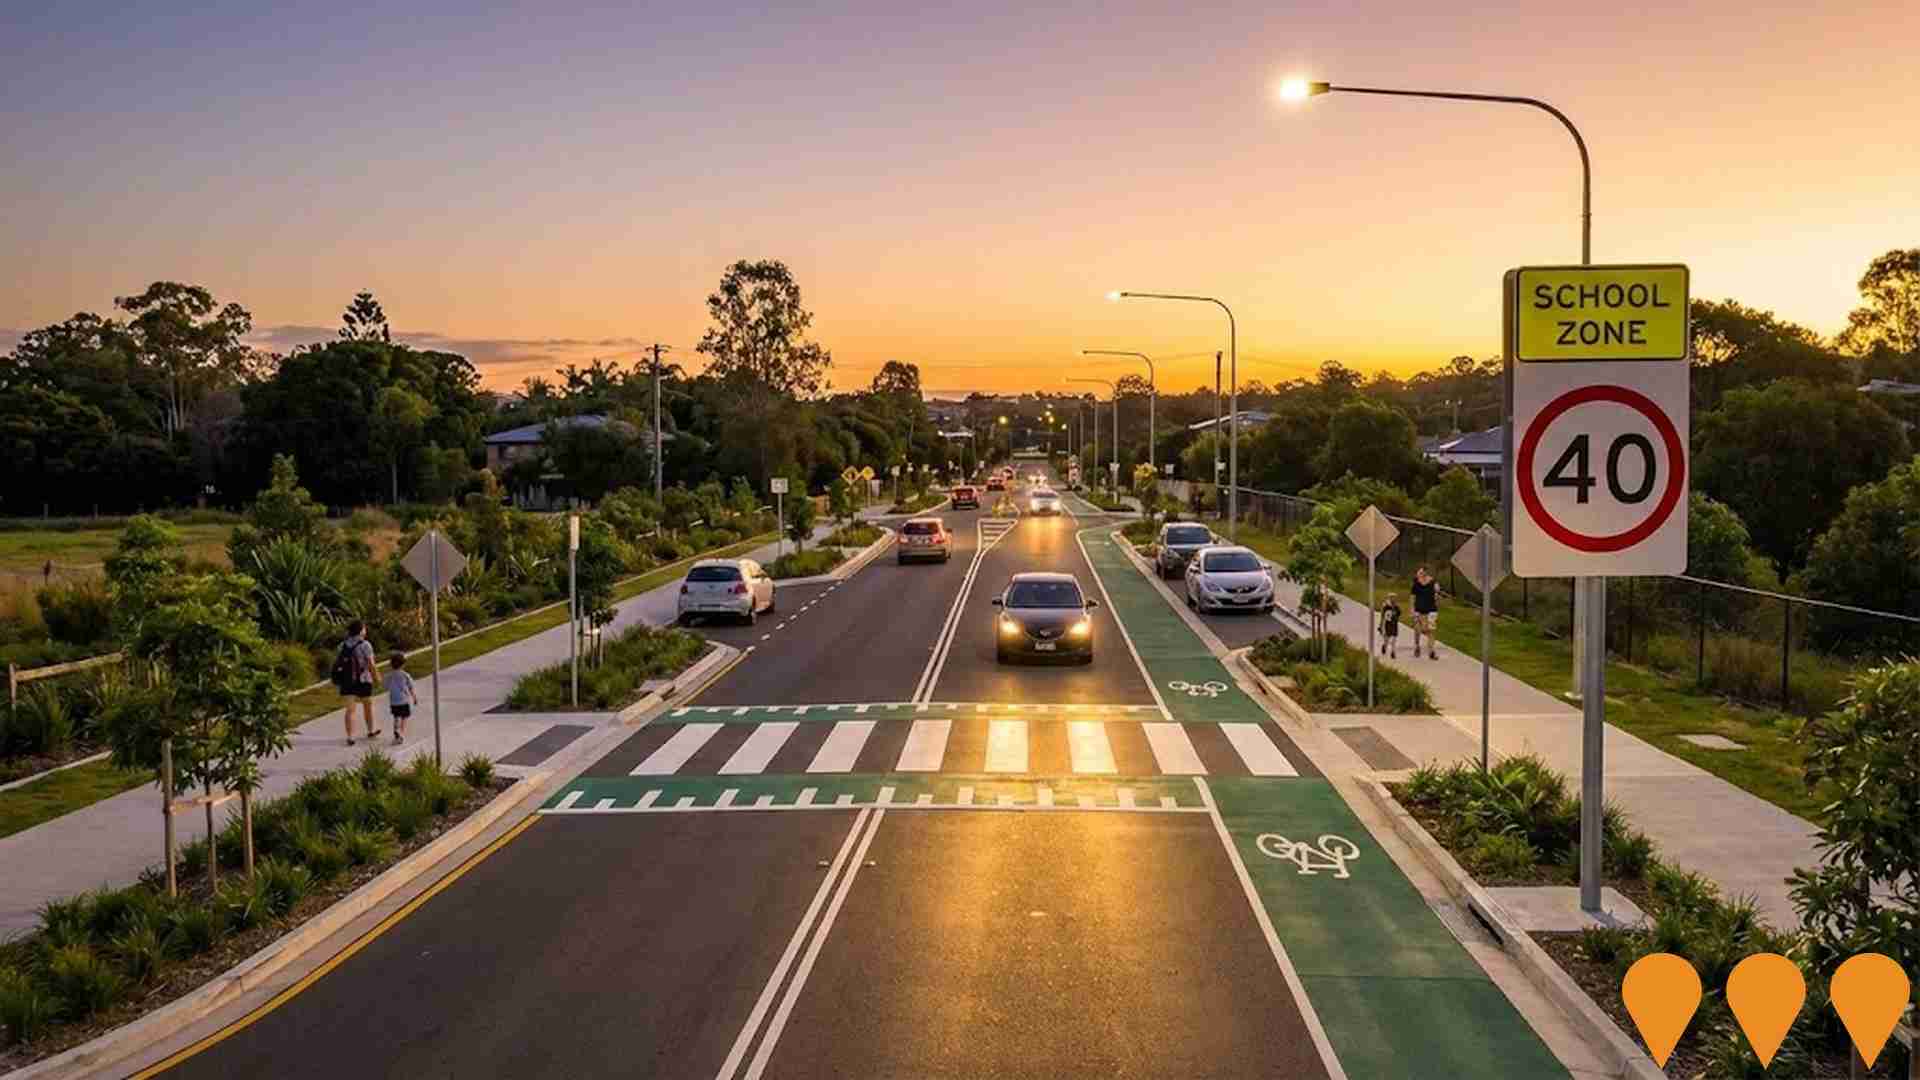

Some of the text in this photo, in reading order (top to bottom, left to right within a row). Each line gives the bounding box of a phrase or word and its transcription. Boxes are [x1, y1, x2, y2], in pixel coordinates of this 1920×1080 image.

[1533, 283, 1671, 309] SCHOOL
[1556, 320, 1647, 345] ZONE
[1542, 433, 1657, 505] 40
